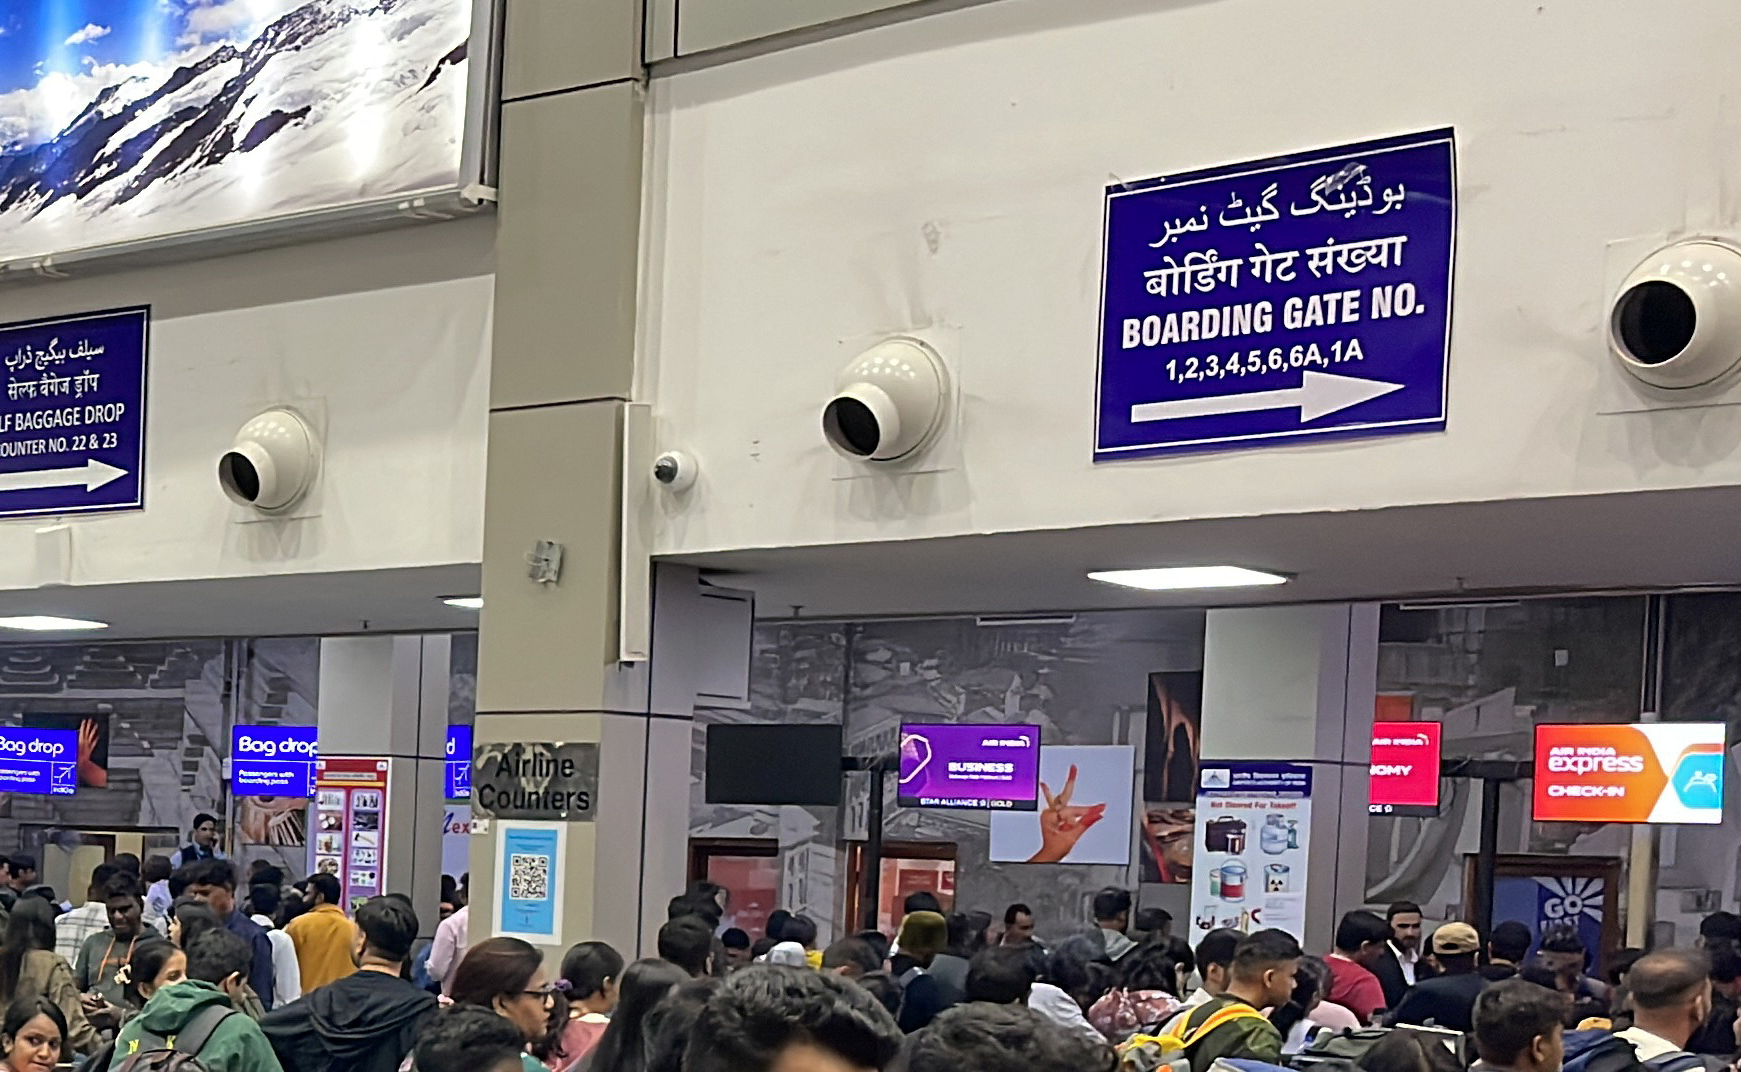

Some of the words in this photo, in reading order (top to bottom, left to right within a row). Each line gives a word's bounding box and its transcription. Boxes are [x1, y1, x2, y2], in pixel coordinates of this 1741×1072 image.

[1148, 204, 1209, 248] نمبر
[1144, 250, 1243, 298] बोर्डिंग
[1250, 243, 1299, 283] गेट
[1305, 236, 1408, 278] संख्या
[1122, 301, 1273, 349] BOARDING
[1283, 290, 1361, 330] GATE
[1371, 282, 1426, 320] NO.
[1165, 338, 1364, 384] 1,2,3,4,5,6,6A,1A
[8, 377, 39, 401] सेल्फ
[39, 371, 71, 397] बैगेज
[73, 369, 100, 399] ड्रॉप
[15, 406, 82, 431] BAGGAGE
[84, 402, 125, 425] DROP
[48, 437, 70, 452] NO.
[72, 435, 86, 451] 22
[88, 433, 99, 449] &
[102, 432, 118, 448] 23
[28, 738, 64, 758] drop
[238, 736, 277, 757] Bag
[1549, 747, 1574, 756] AIR
[1577, 747, 1617, 756] INDIA
[495, 751, 575, 778] Airline
[947, 762, 1014, 773] BUSINESS
[1548, 756, 1644, 776] express
[478, 783, 591, 811] Counters
[920, 798, 940, 806] STAR
[941, 799, 978, 807] ALLIANCE
[990, 800, 1013, 808] GOLD
[1548, 785, 1625, 797] CHECK-IN
[1544, 895, 1583, 919] GO
